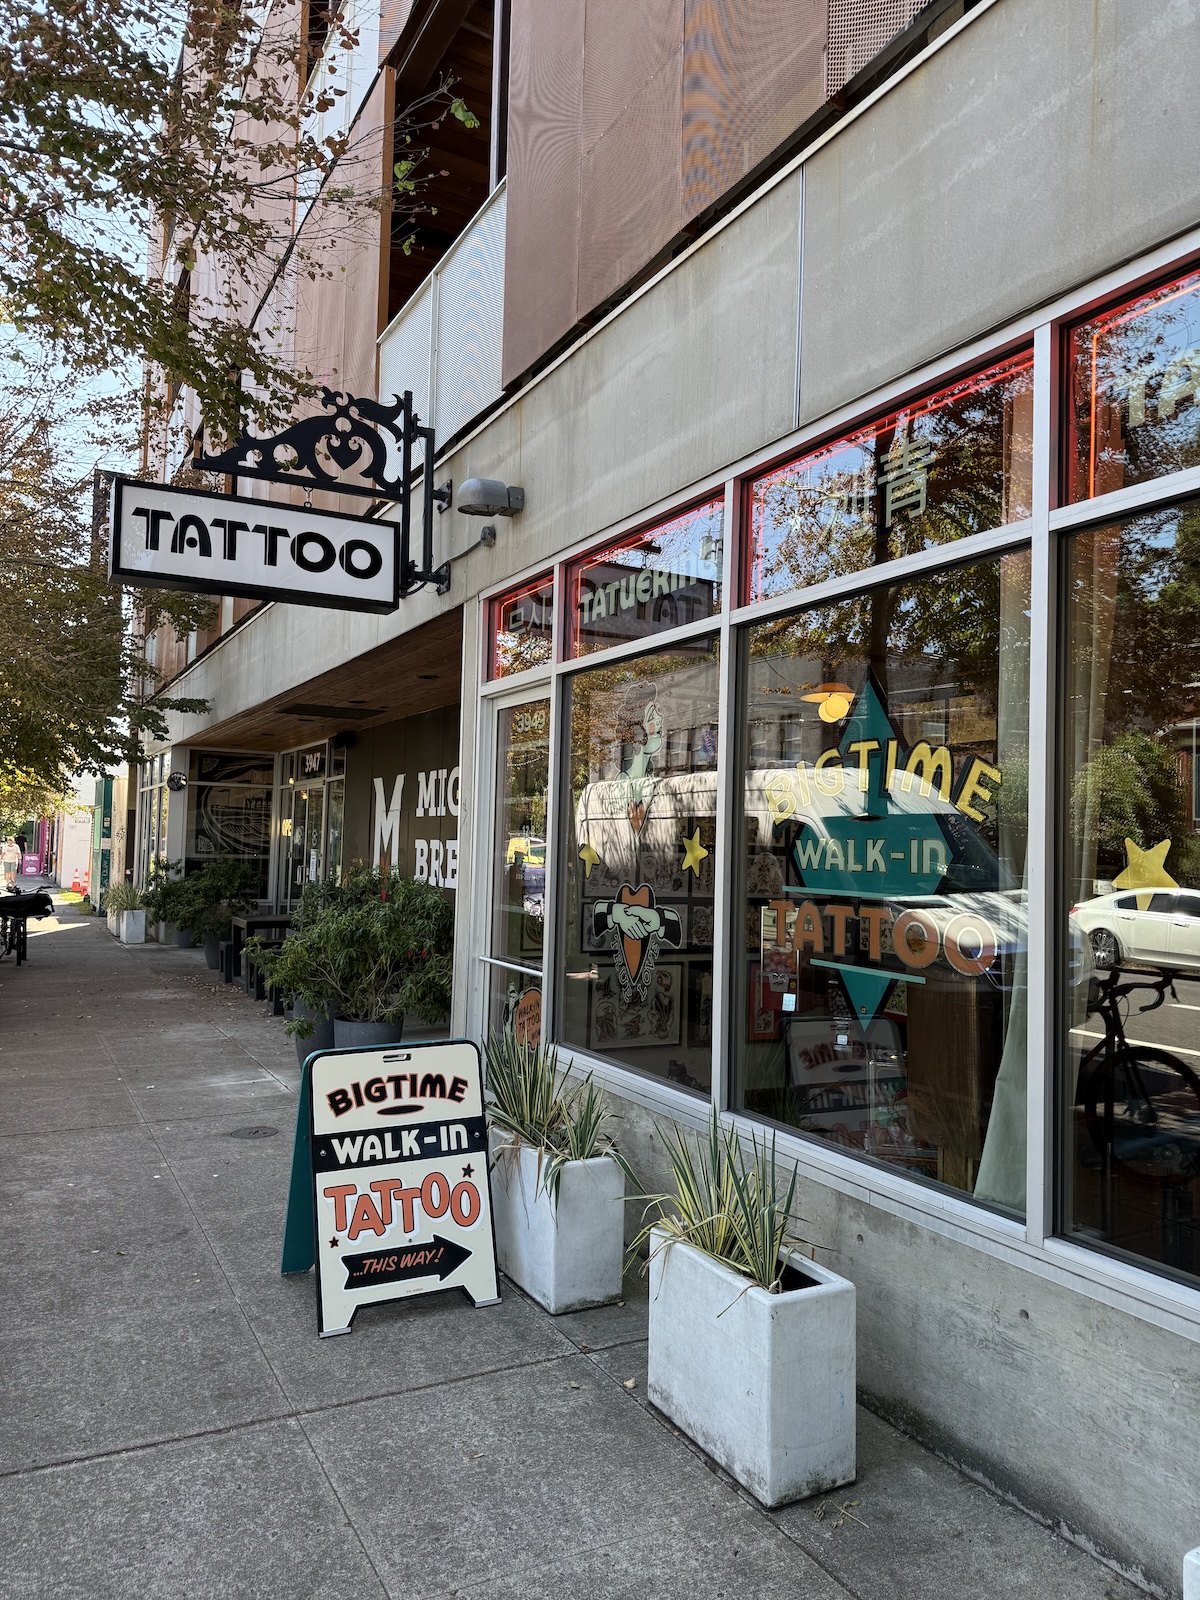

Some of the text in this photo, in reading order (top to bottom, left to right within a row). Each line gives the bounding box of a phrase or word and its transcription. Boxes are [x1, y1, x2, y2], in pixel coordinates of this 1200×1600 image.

[131, 507, 383, 580] TATTOO
[516, 710, 546, 734] 3949
[305, 752, 321, 774] 3947
[764, 740, 1003, 826] BIGTIME
[414, 838, 458, 889] BRE
[795, 838, 947, 876] WALK-IN
[768, 900, 998, 977] TATTOO
[610, 933, 632, 1002] TRUE
[637, 940, 660, 1002] LOVE
[326, 1073, 469, 1118] BIGTIME
[331, 1123, 469, 1165] WALK-IN
[323, 1171, 482, 1241] TATTOO
[400, 1247, 445, 1269] WAY!
